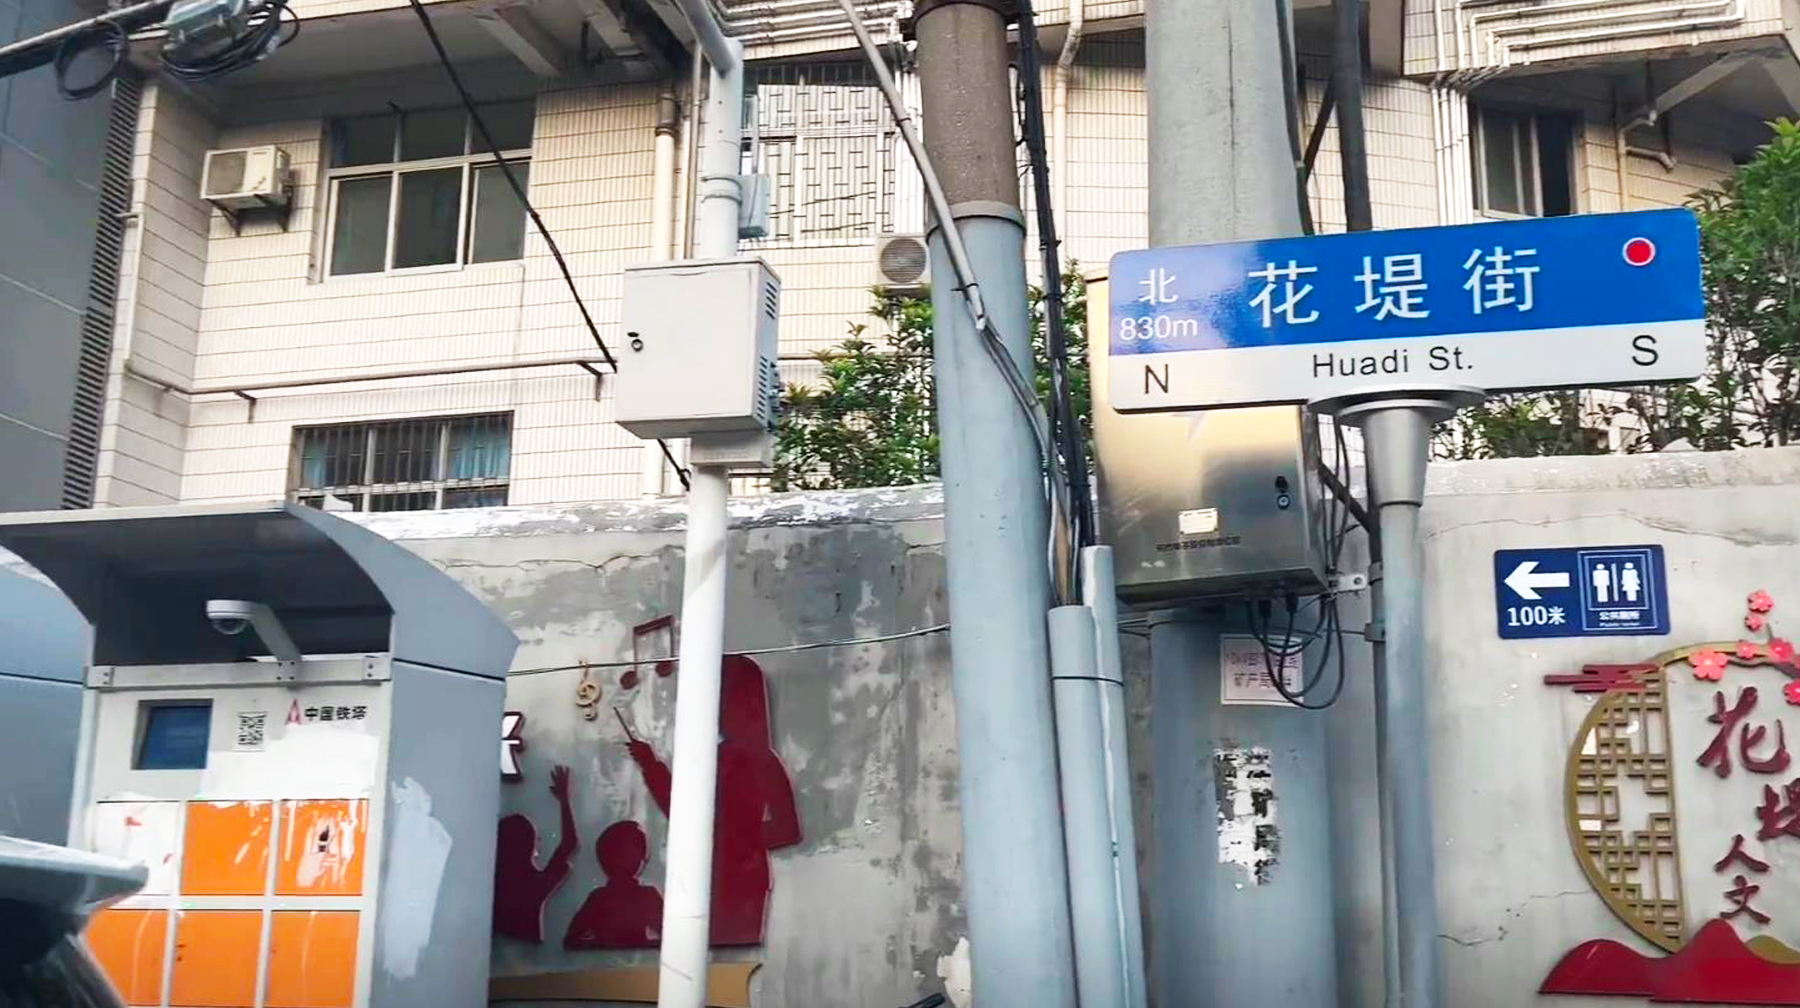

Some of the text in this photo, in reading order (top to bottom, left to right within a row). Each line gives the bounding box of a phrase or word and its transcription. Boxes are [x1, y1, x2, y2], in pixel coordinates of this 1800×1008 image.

[1138, 267, 1179, 306] 北
[1248, 245, 1541, 329] 花堤街
[1119, 315, 1198, 341] 830m
[1312, 345, 1474, 378] Huadi St.
[1631, 334, 1660, 367] S
[1143, 363, 1170, 395] N
[1507, 605, 1566, 627] 100米
[304, 705, 367, 722] 中国铁塔
[1714, 833, 1772, 924] 人文
